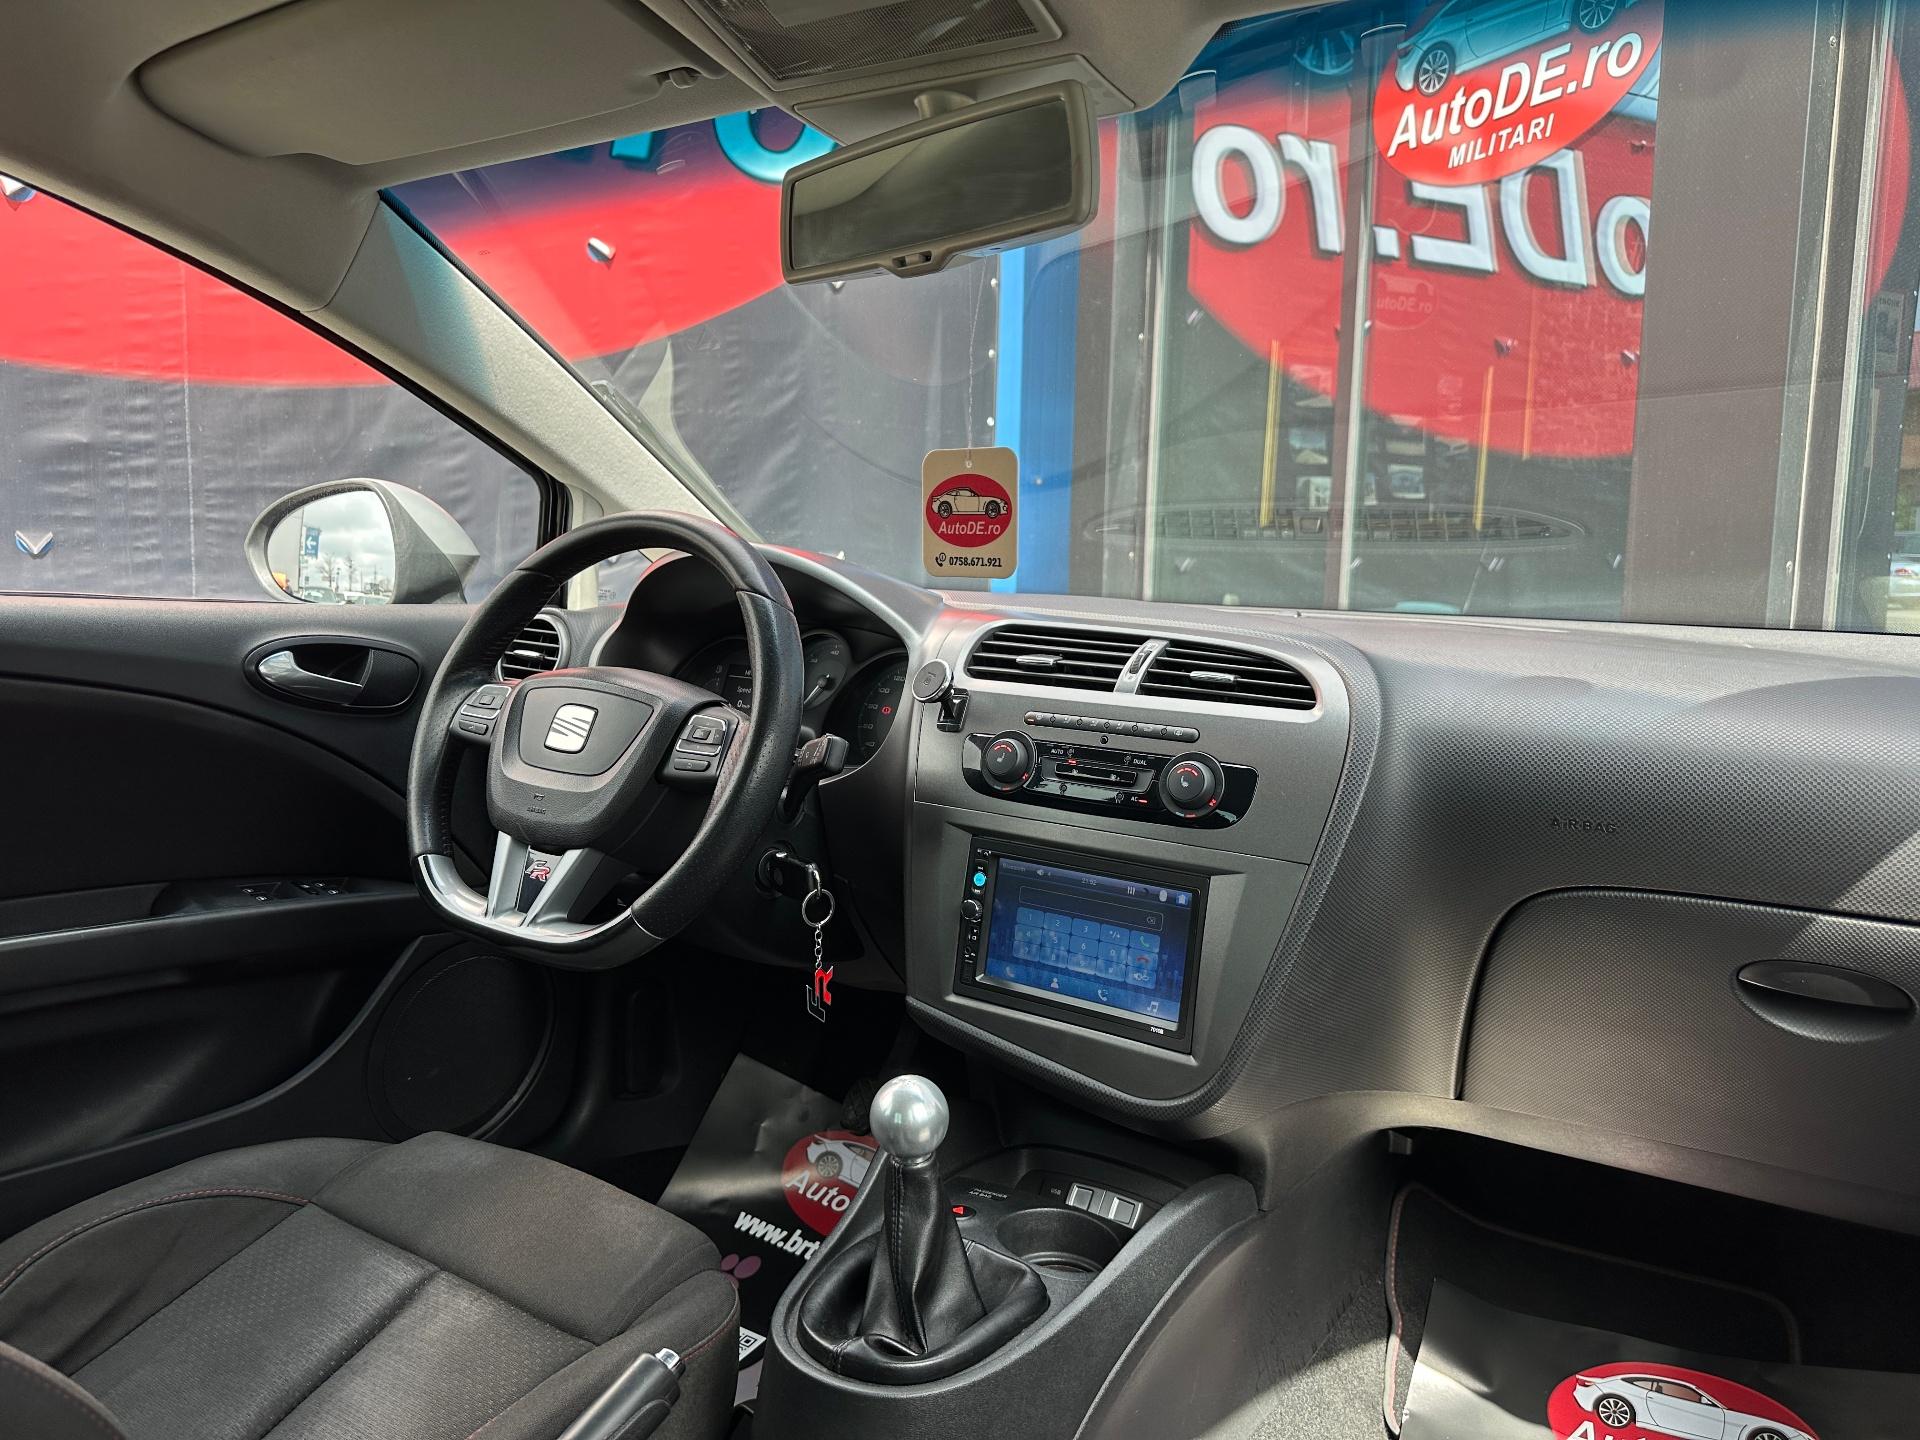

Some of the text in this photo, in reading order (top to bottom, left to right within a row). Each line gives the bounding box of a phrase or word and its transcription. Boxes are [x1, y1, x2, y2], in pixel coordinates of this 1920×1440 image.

[1387, 32, 1642, 158] AutoDE.ro
[1448, 113, 1555, 169] MILITARI
[938, 521, 1001, 535] AutoDE.ro
[949, 556, 1002, 567] 0758.671.921
[1133, 758, 1147, 766] DUAL
[1552, 815, 1617, 834] AIRBAG
[525, 860, 550, 882] FR
